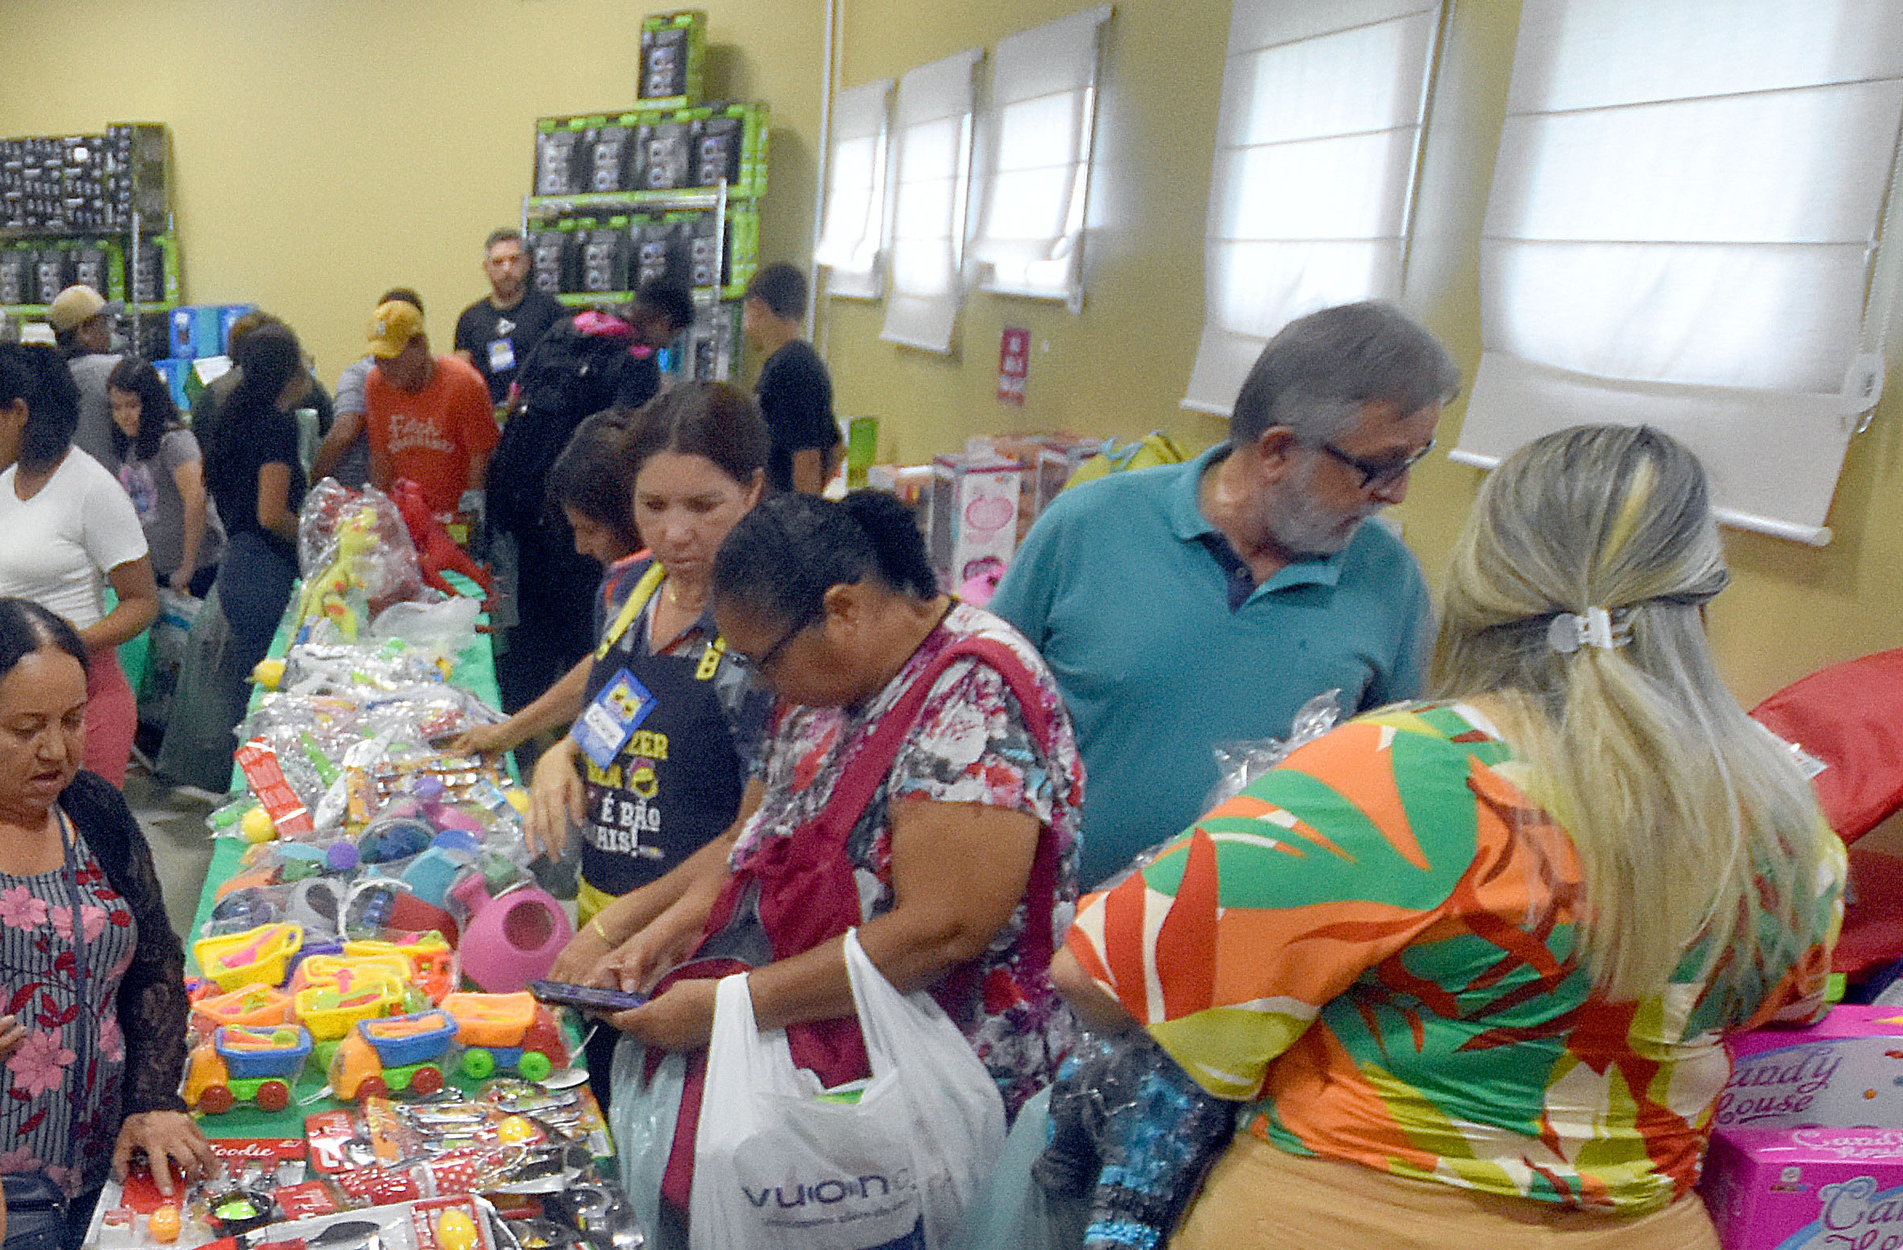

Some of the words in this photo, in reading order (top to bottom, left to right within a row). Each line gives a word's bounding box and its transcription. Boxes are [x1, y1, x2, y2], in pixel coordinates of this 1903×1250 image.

[596, 824, 640, 858] AIS!
[1728, 1048, 1843, 1094] andy
[1821, 1176, 1903, 1231] Ca
